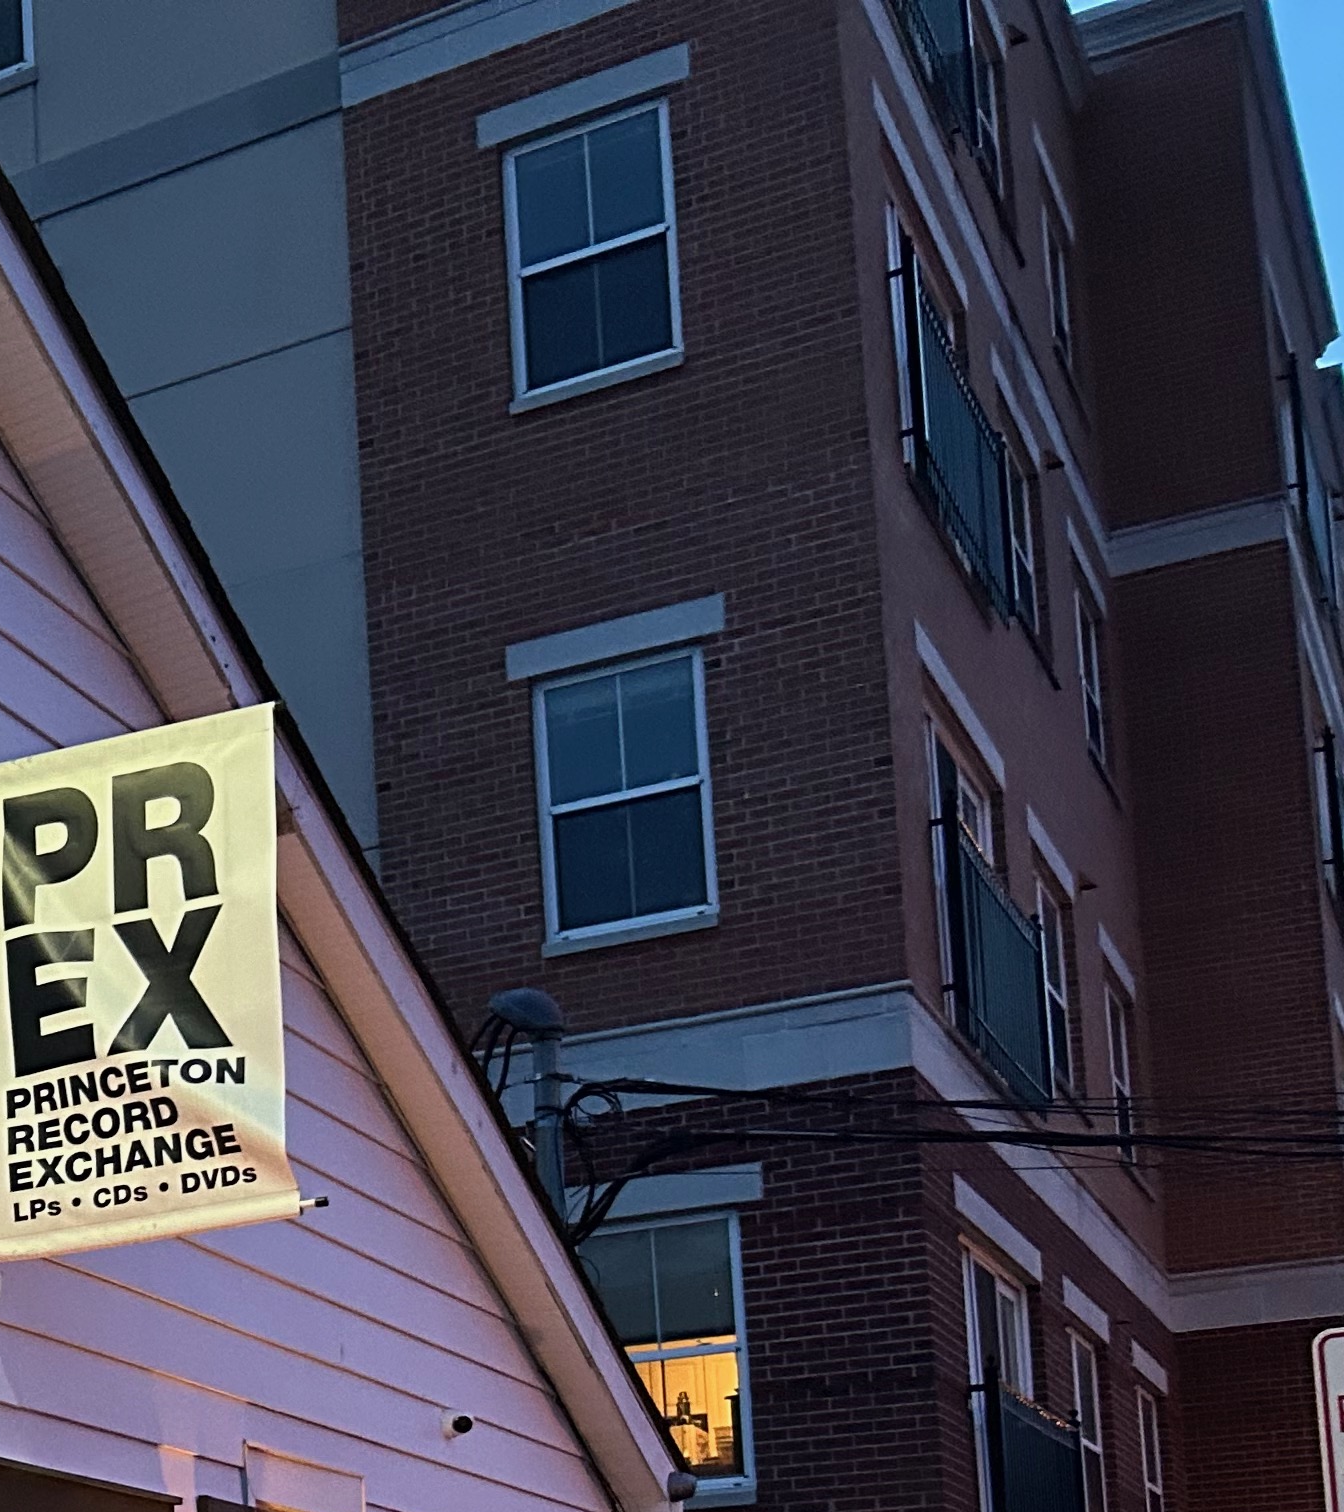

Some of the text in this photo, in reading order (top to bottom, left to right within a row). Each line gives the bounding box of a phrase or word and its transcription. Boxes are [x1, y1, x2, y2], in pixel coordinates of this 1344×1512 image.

[3, 761, 219, 931] PR
[6, 903, 233, 1077] EX
[6, 1056, 246, 1121] PRINCETON
[8, 1096, 178, 1155] RECORD
[9, 1123, 241, 1192] EXCHANGE
[13, 1164, 257, 1222] LPs CDs DVDs
